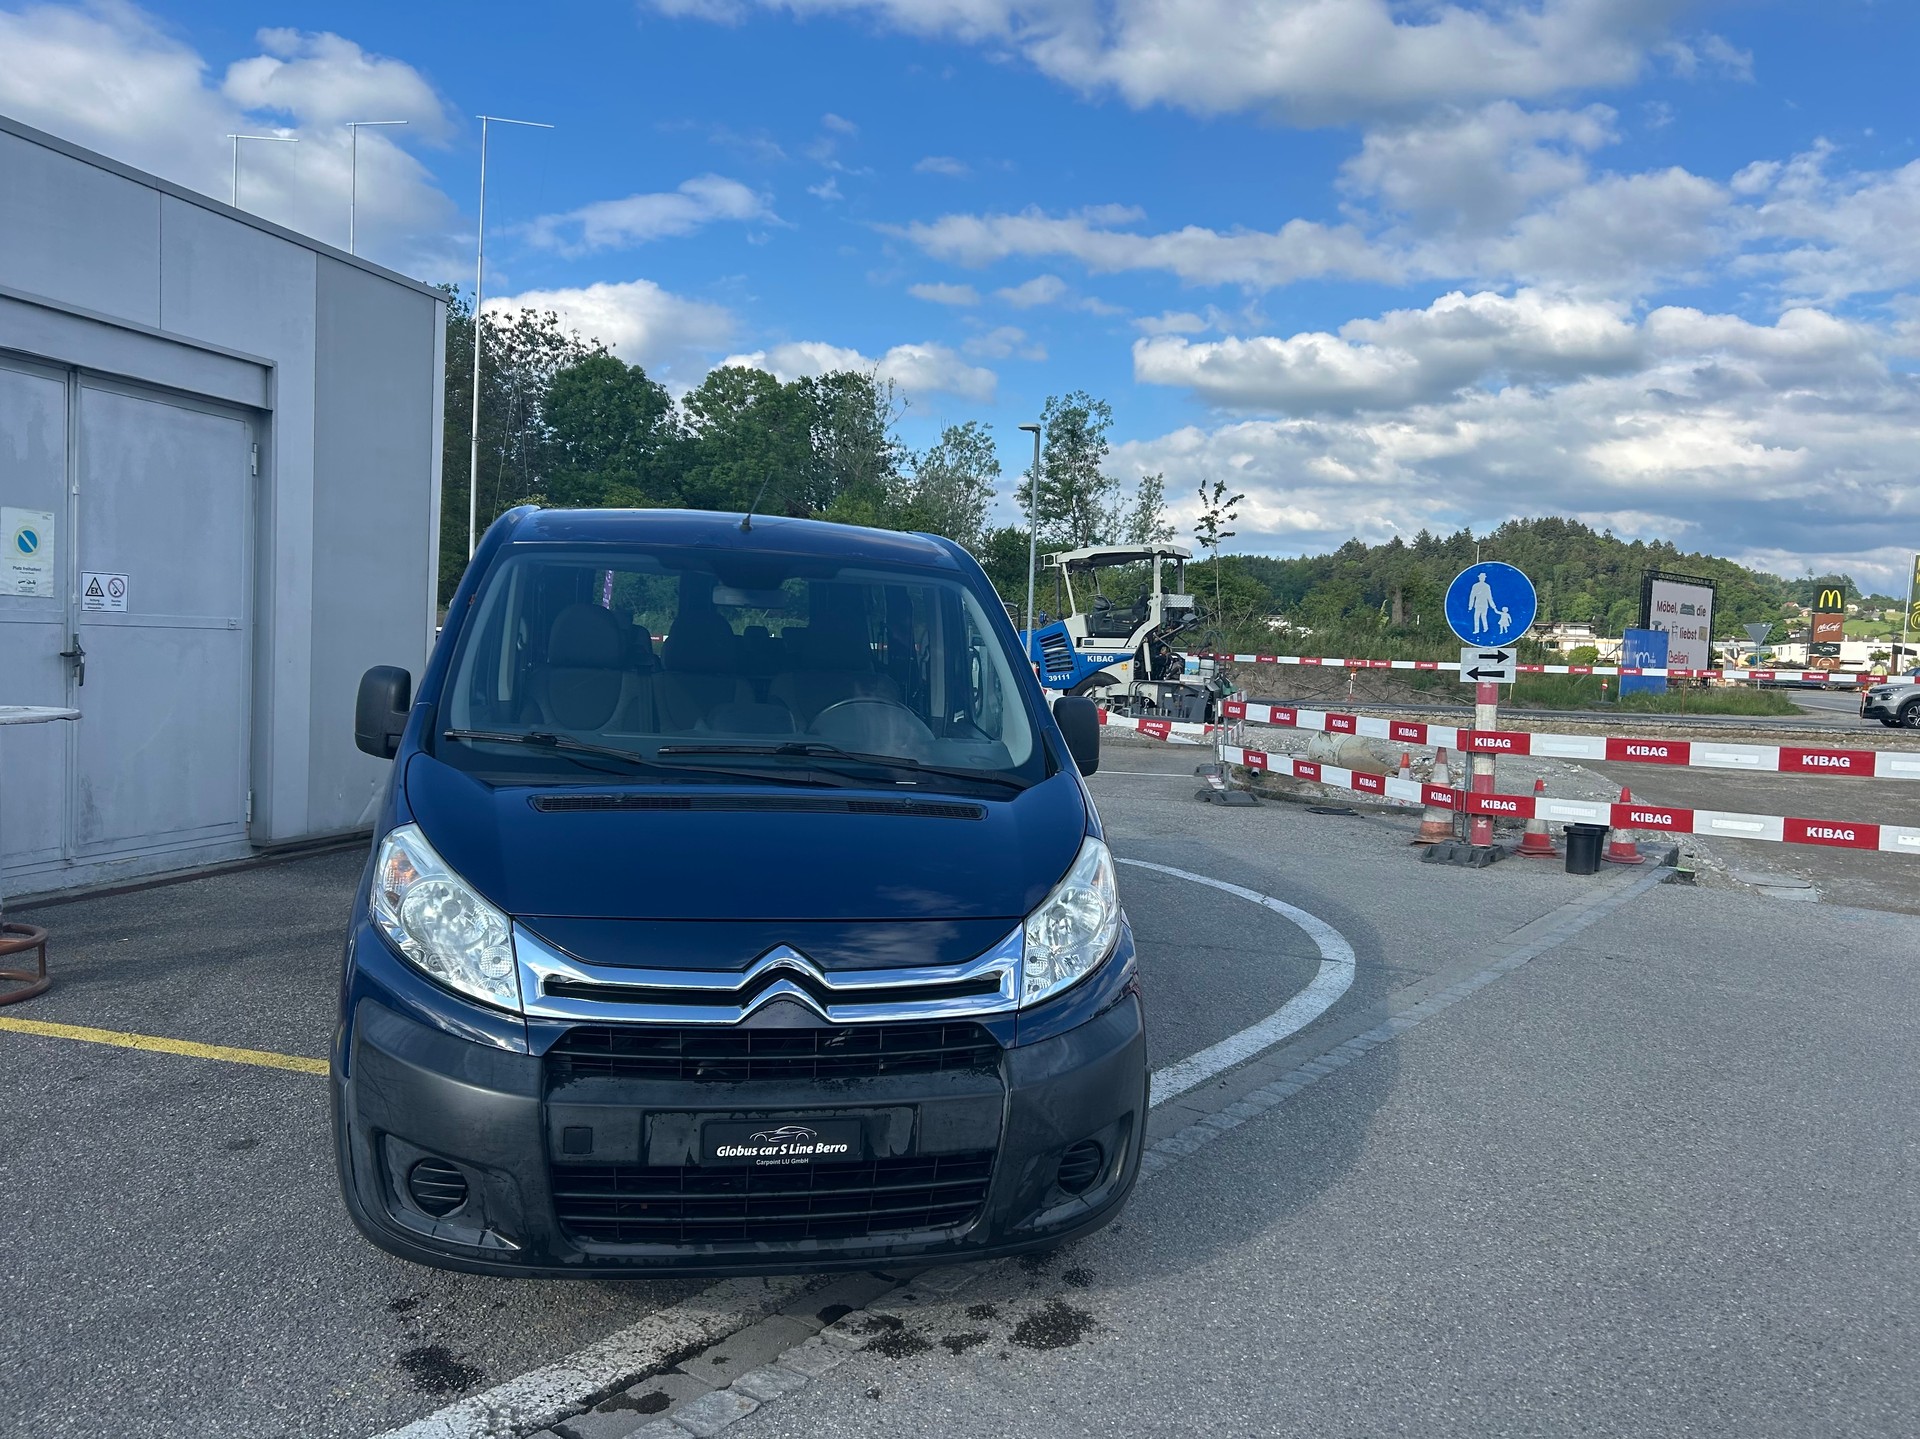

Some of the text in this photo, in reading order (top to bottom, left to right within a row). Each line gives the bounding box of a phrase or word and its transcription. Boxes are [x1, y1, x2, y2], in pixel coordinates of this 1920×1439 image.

[90, 587, 99, 595] EX
[1656, 600, 1707, 617] Möbel, die
[1679, 627, 1697, 640] liebst
[1087, 655, 1114, 663] KIBAG
[1048, 674, 1070, 682] 39111
[1275, 712, 1291, 720] KIBAG
[1332, 719, 1349, 729] KIBAG
[1398, 727, 1418, 738] KIBAG
[1474, 737, 1512, 749] KIBAG
[1626, 745, 1668, 757] KIBAG
[1248, 755, 1262, 764] KIBAG
[1802, 755, 1851, 768] KIBAG
[1299, 765, 1315, 775] KIBAG
[1359, 777, 1377, 788] KIBAG
[1430, 791, 1452, 803] KIBAG
[1481, 799, 1517, 811] KIBAG
[1630, 812, 1673, 825] KIBAG
[1806, 827, 1855, 841] KIBAG
[716, 1142, 848, 1157] Globus car S Line Berro
[756, 1159, 781, 1167] Carpoint
